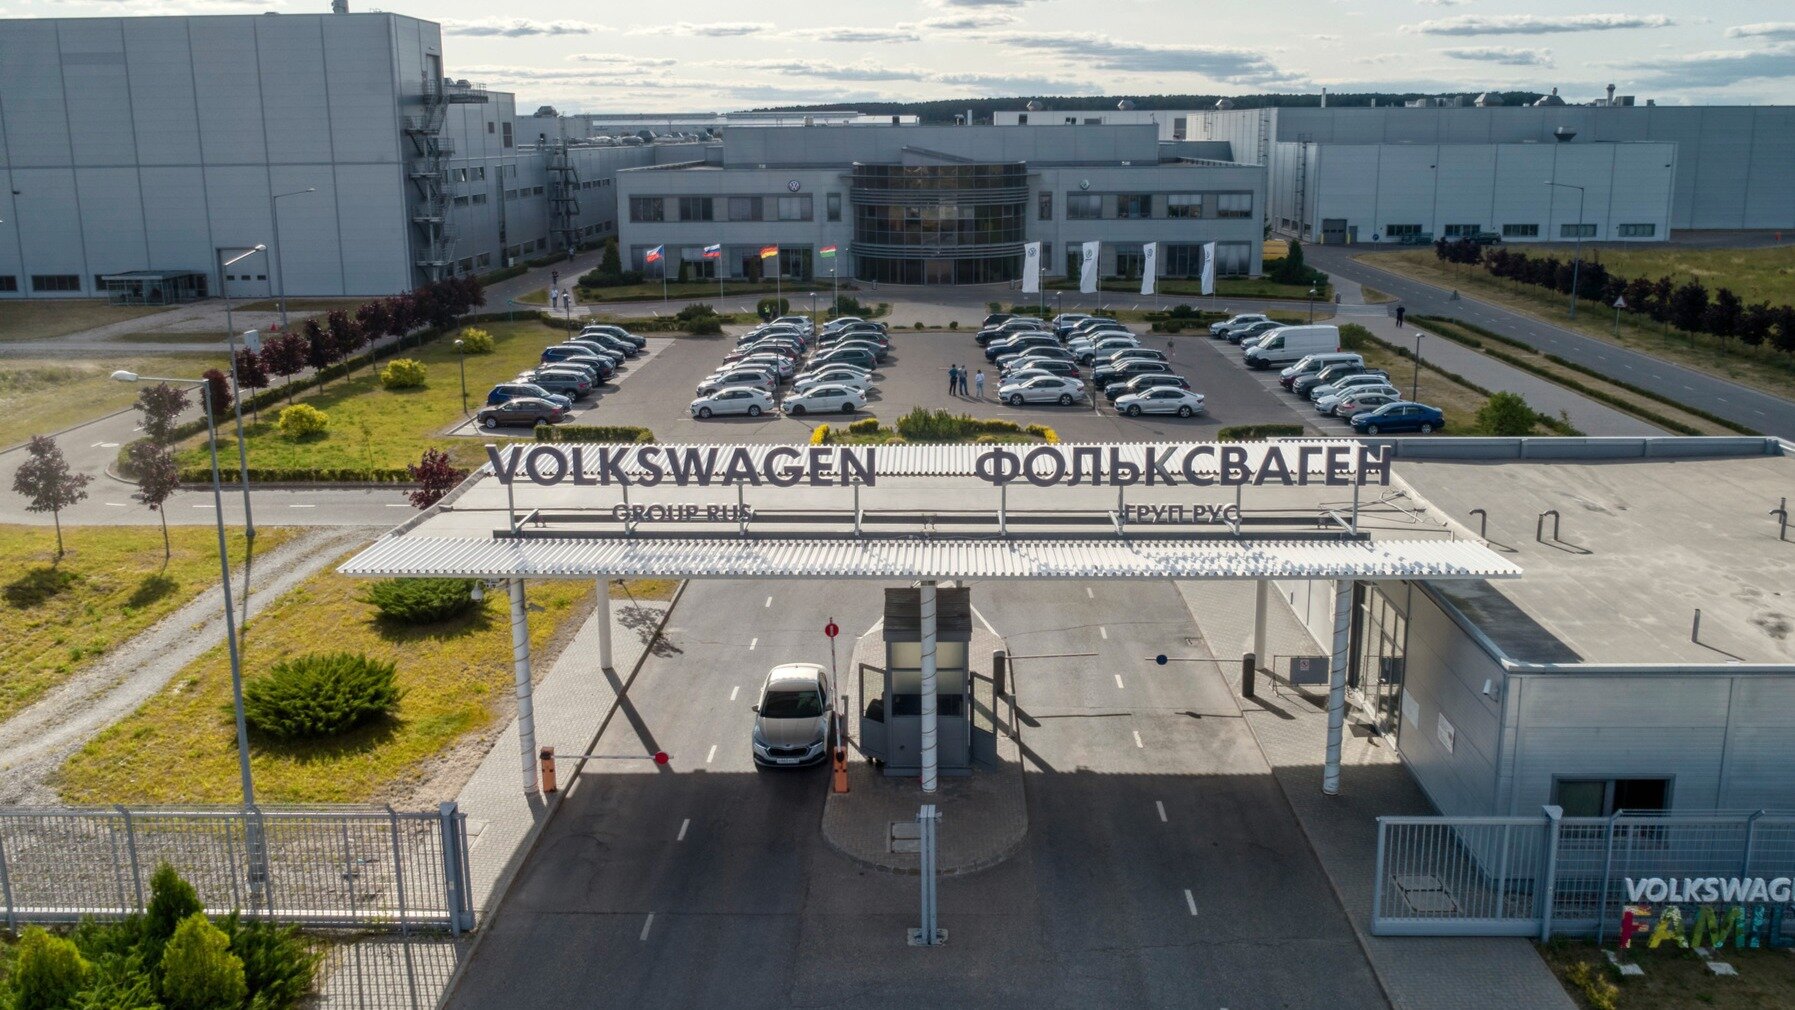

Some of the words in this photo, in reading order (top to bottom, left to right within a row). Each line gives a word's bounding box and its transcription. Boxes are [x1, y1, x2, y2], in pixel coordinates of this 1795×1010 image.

[485, 443, 877, 487] VOLKSWAGEN
[975, 444, 1392, 487] ФОЛЬКСВАГЕН
[611, 502, 699, 522] GROUP
[708, 503, 753, 523] RUS
[1124, 503, 1184, 524] ГРУП
[1193, 503, 1242, 524] РУС
[1624, 877, 1795, 902] VOLKSWAG
